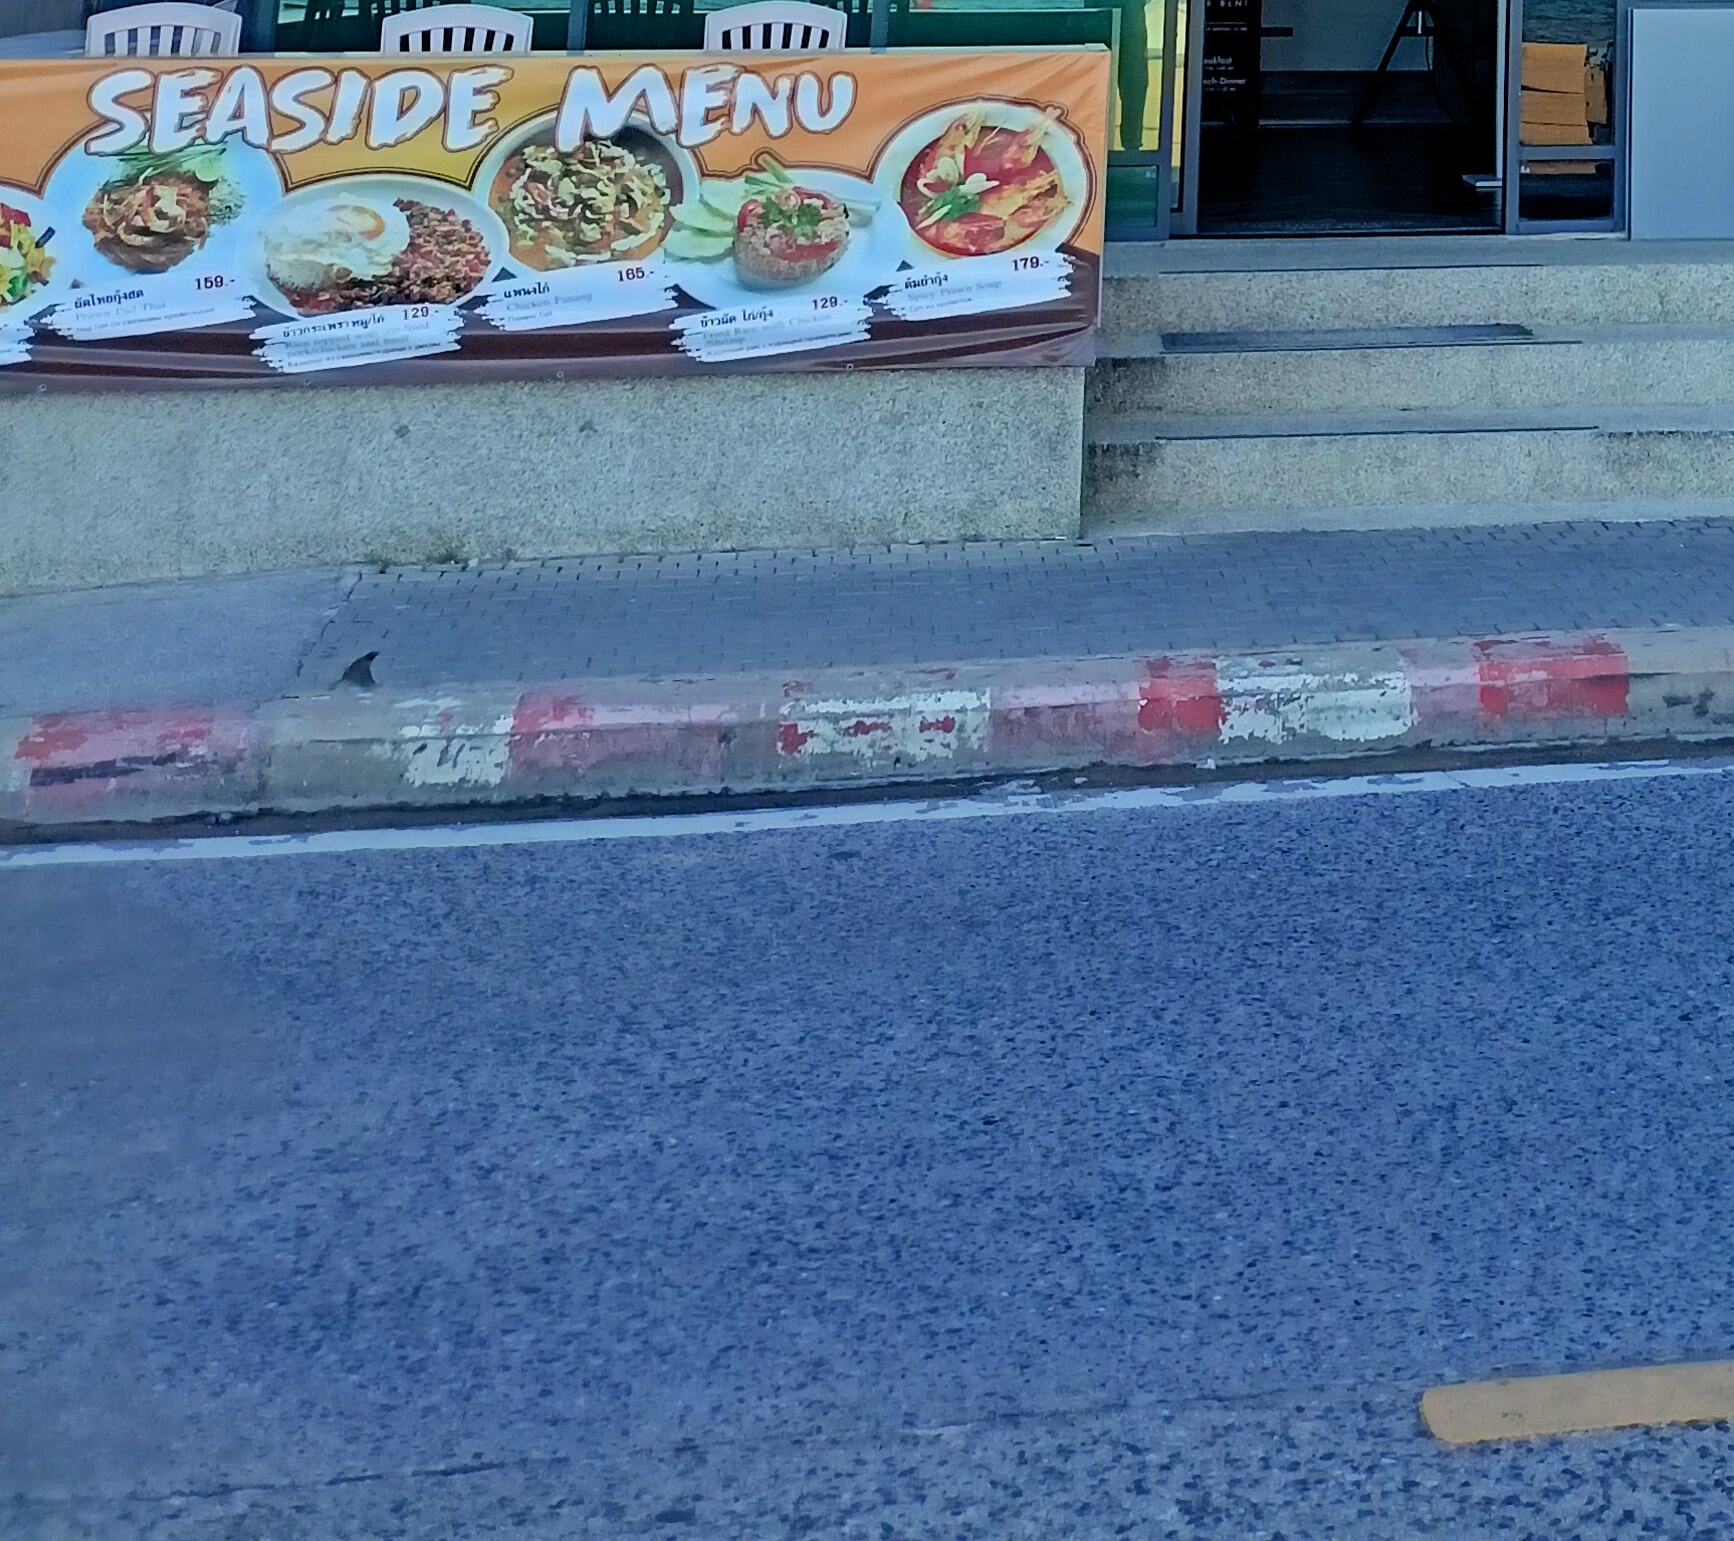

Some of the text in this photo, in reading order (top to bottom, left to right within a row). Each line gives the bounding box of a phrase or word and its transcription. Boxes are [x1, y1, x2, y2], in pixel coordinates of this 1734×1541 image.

[84, 63, 858, 155] SEASIDE MENU
[904, 271, 948, 290] ต้มยำกุ้ง
